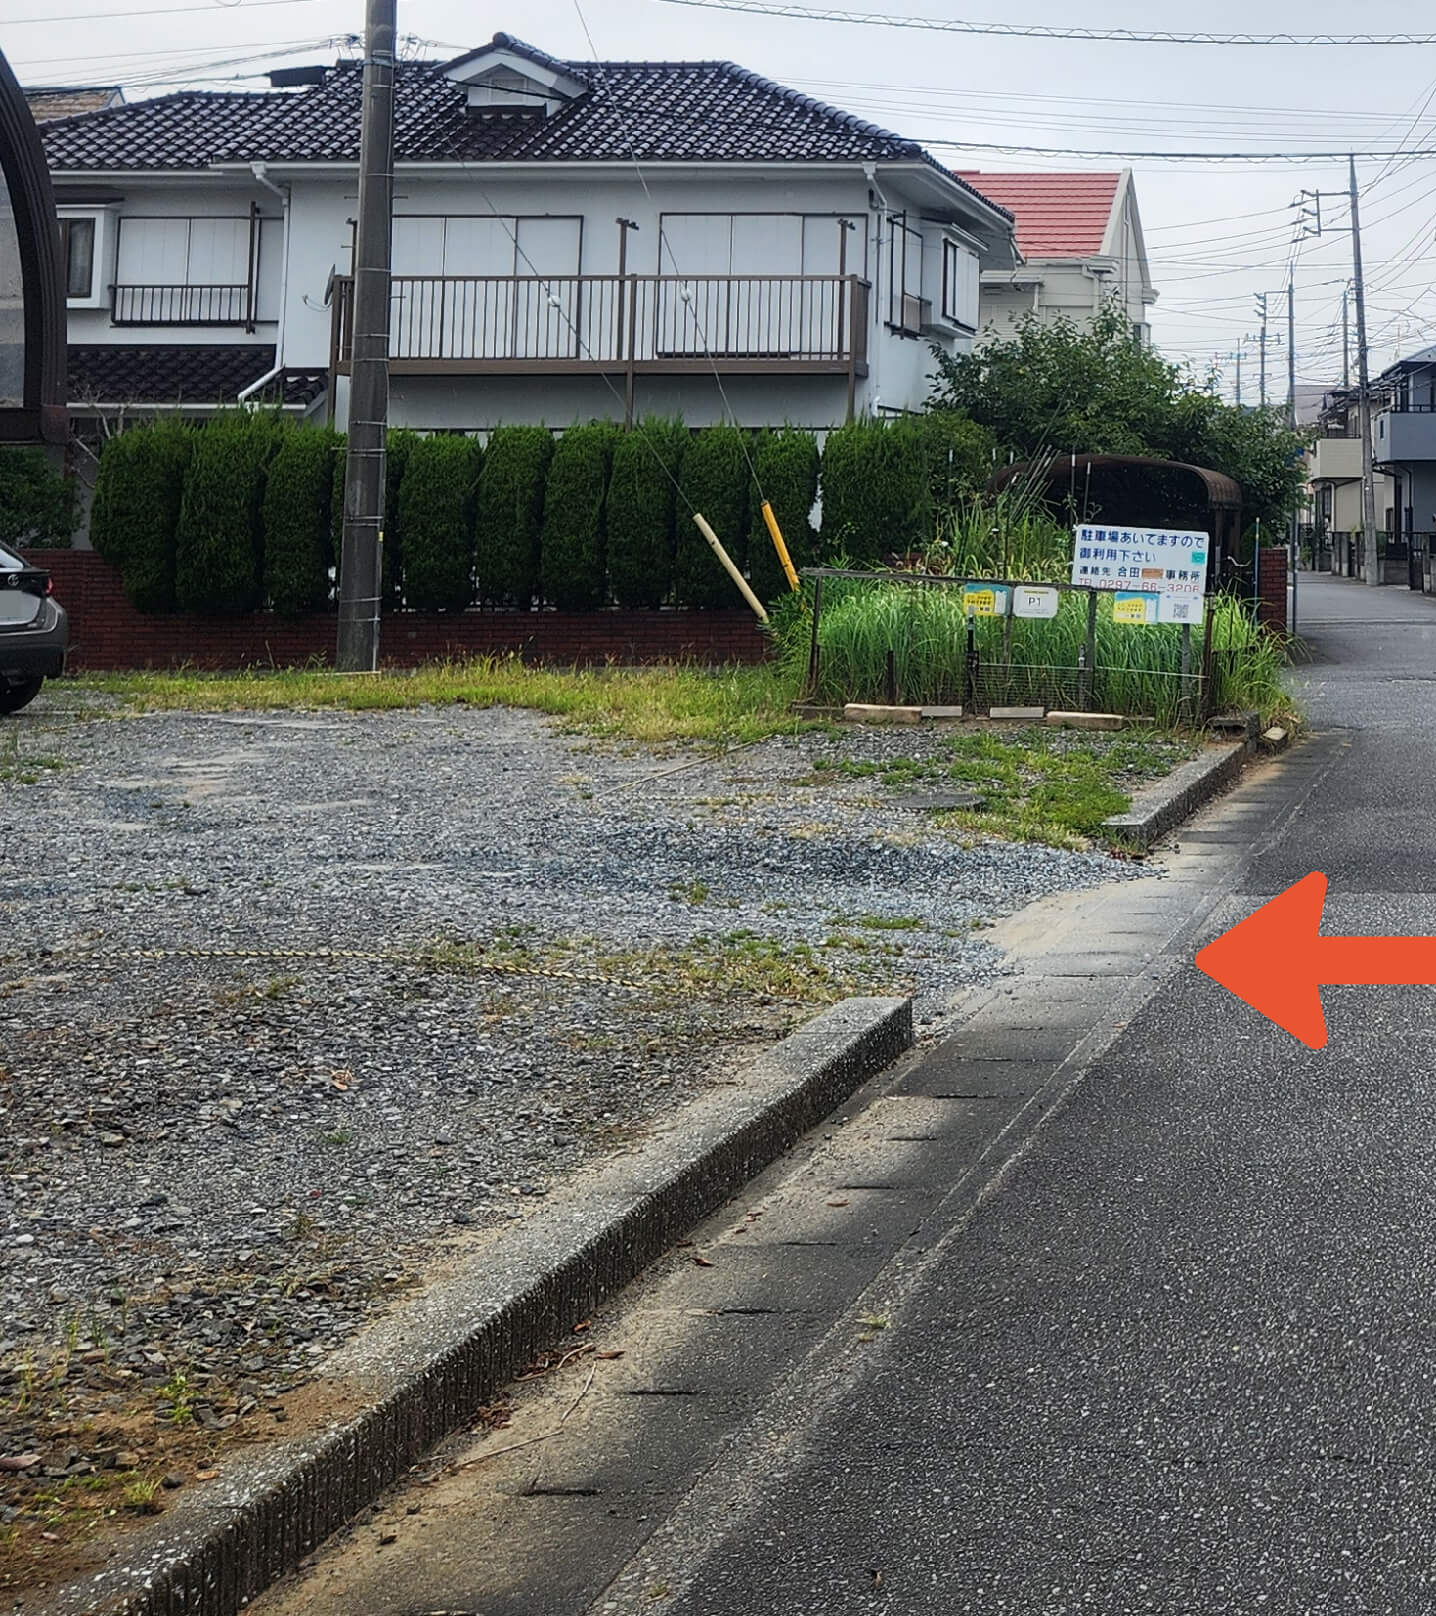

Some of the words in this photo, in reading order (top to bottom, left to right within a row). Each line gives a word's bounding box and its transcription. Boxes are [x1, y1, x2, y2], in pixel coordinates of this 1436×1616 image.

[1081, 528, 1205, 548] 駐車場あいてますので
[1079, 547, 1157, 563] 御利用下さい
